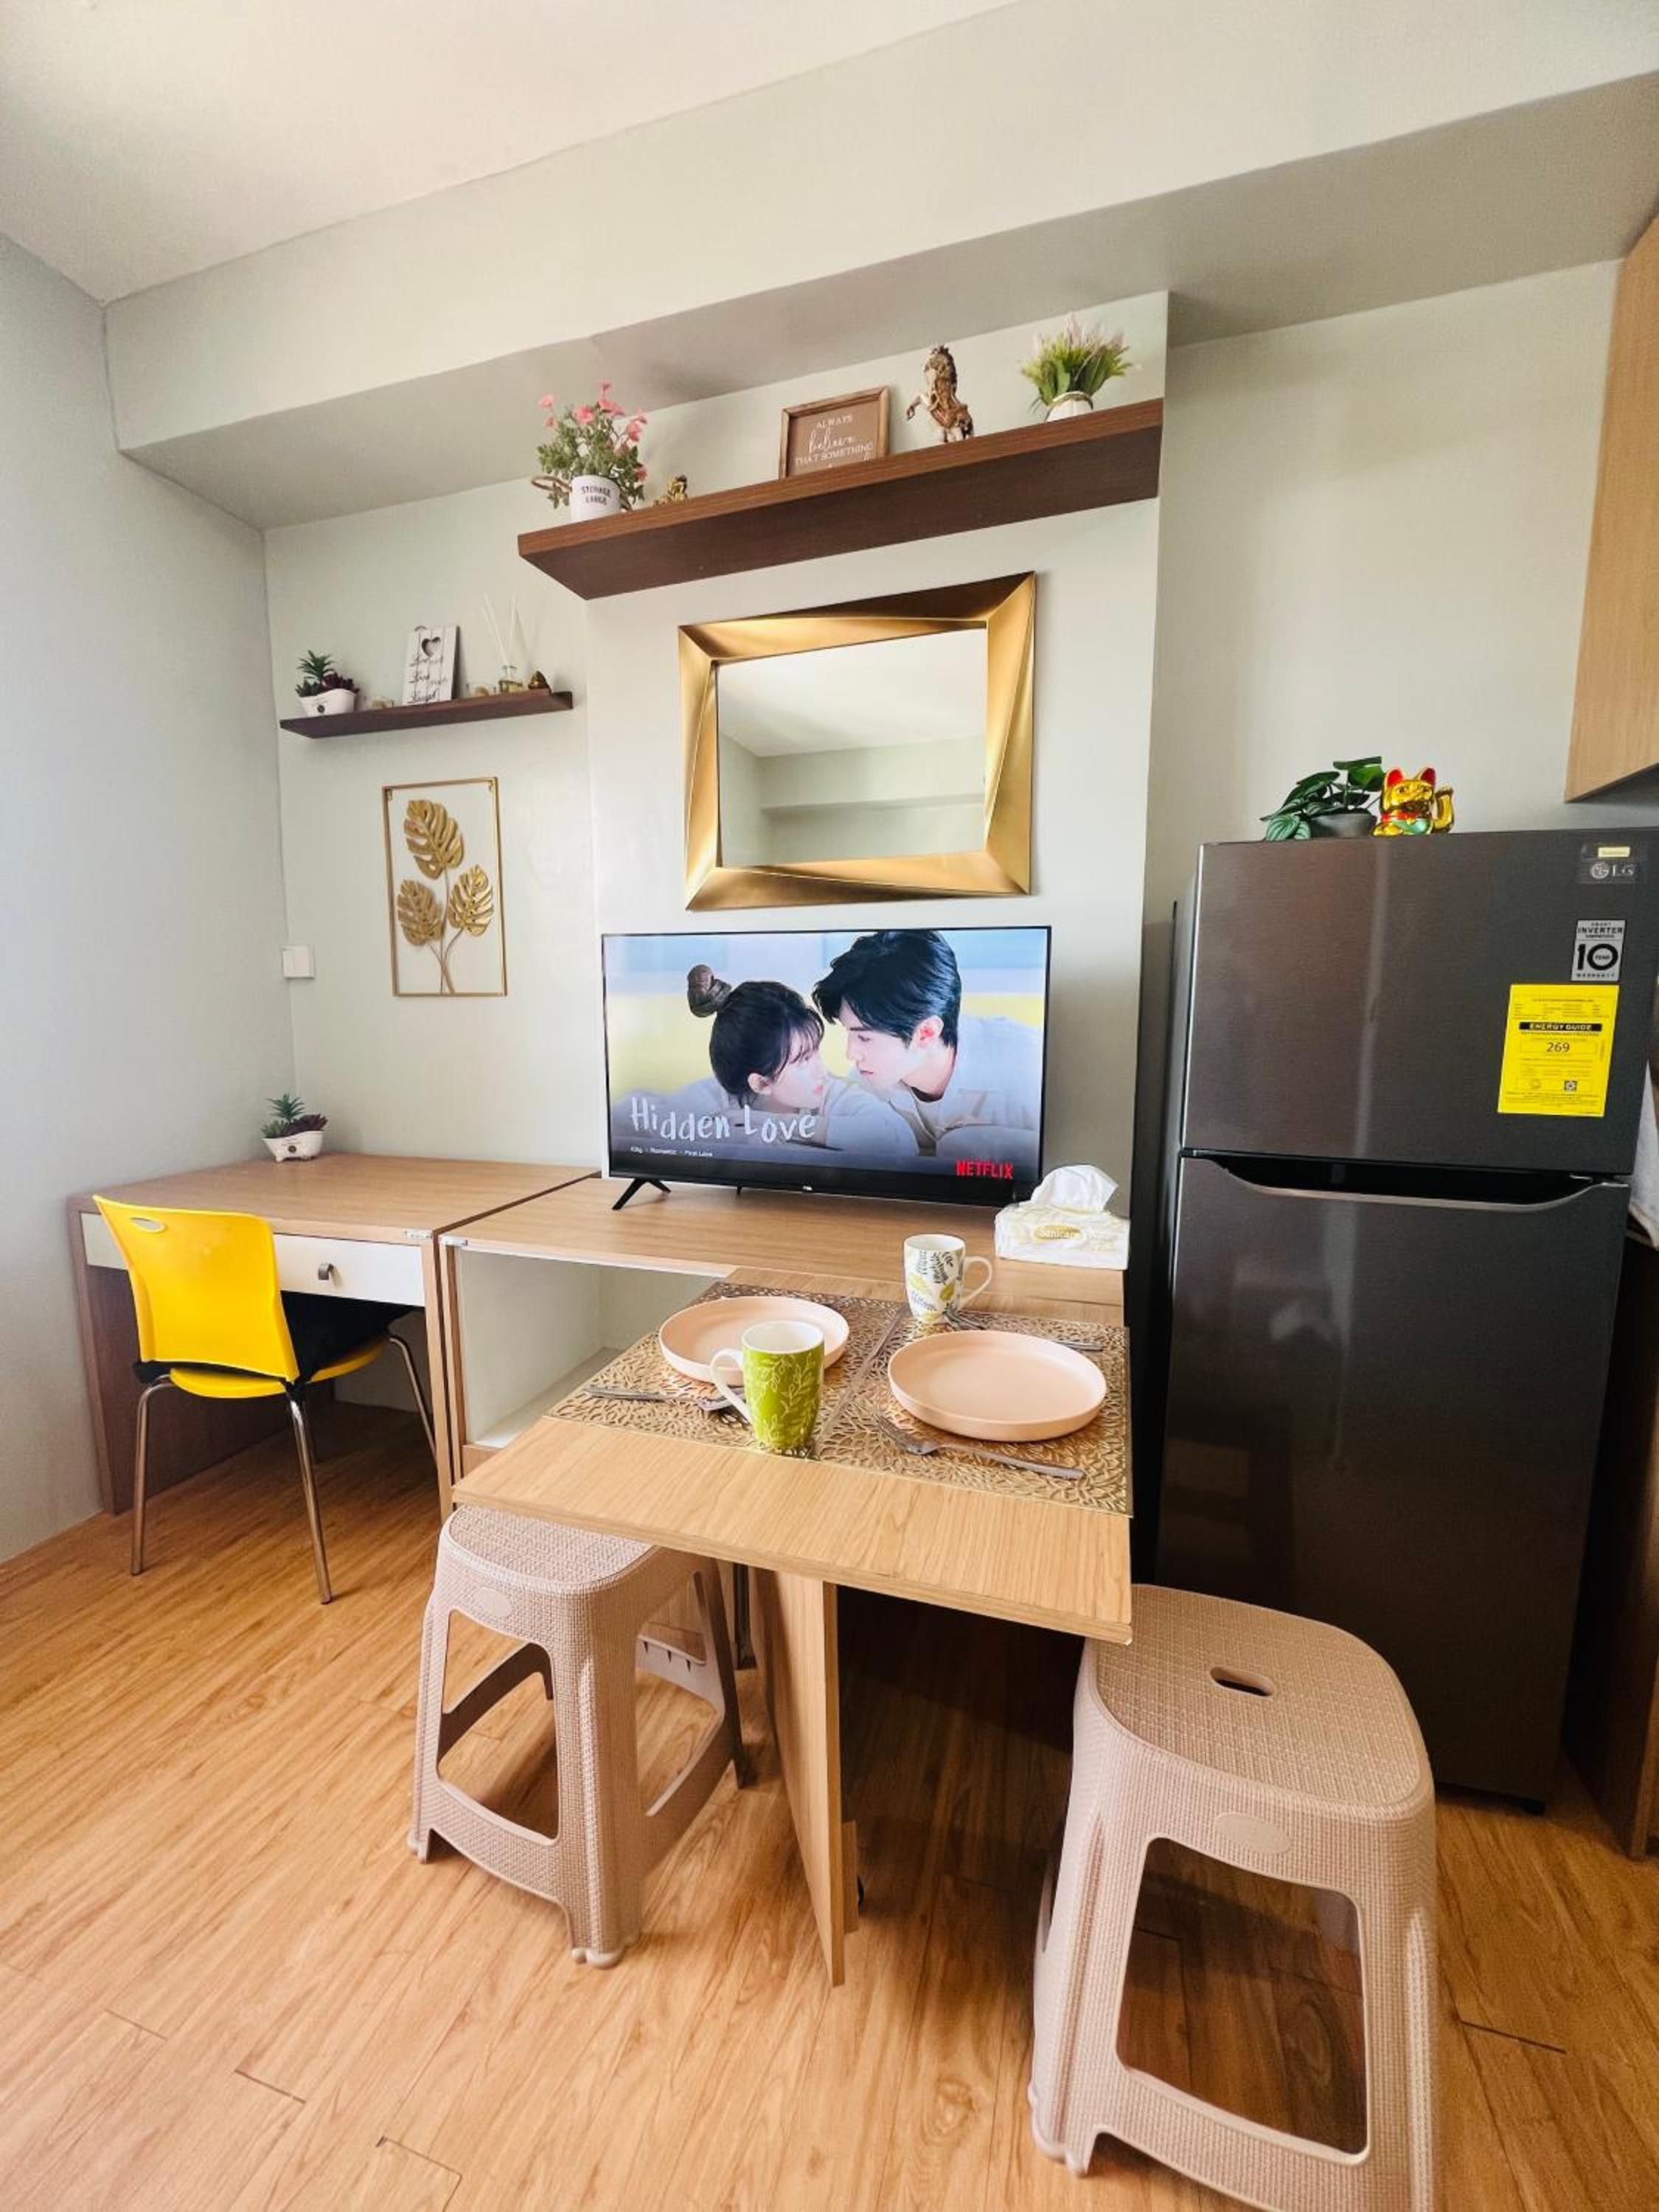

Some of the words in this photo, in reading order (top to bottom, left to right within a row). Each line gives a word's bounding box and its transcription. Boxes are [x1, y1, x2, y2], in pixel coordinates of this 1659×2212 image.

[816, 414, 853, 429] ALWAYS
[809, 428, 855, 453] believe
[796, 453, 819, 467] THAT
[821, 442, 874, 462] SOMETHING
[1612, 863, 1635, 877] LG
[1576, 943, 1619, 971] 10
[1529, 1023, 1564, 1031] ENERGY
[1546, 1041, 1570, 1053] 269
[629, 1096, 731, 1141] Hidden
[742, 1104, 816, 1143] Love
[956, 1159, 1014, 1180] NETFLIX
